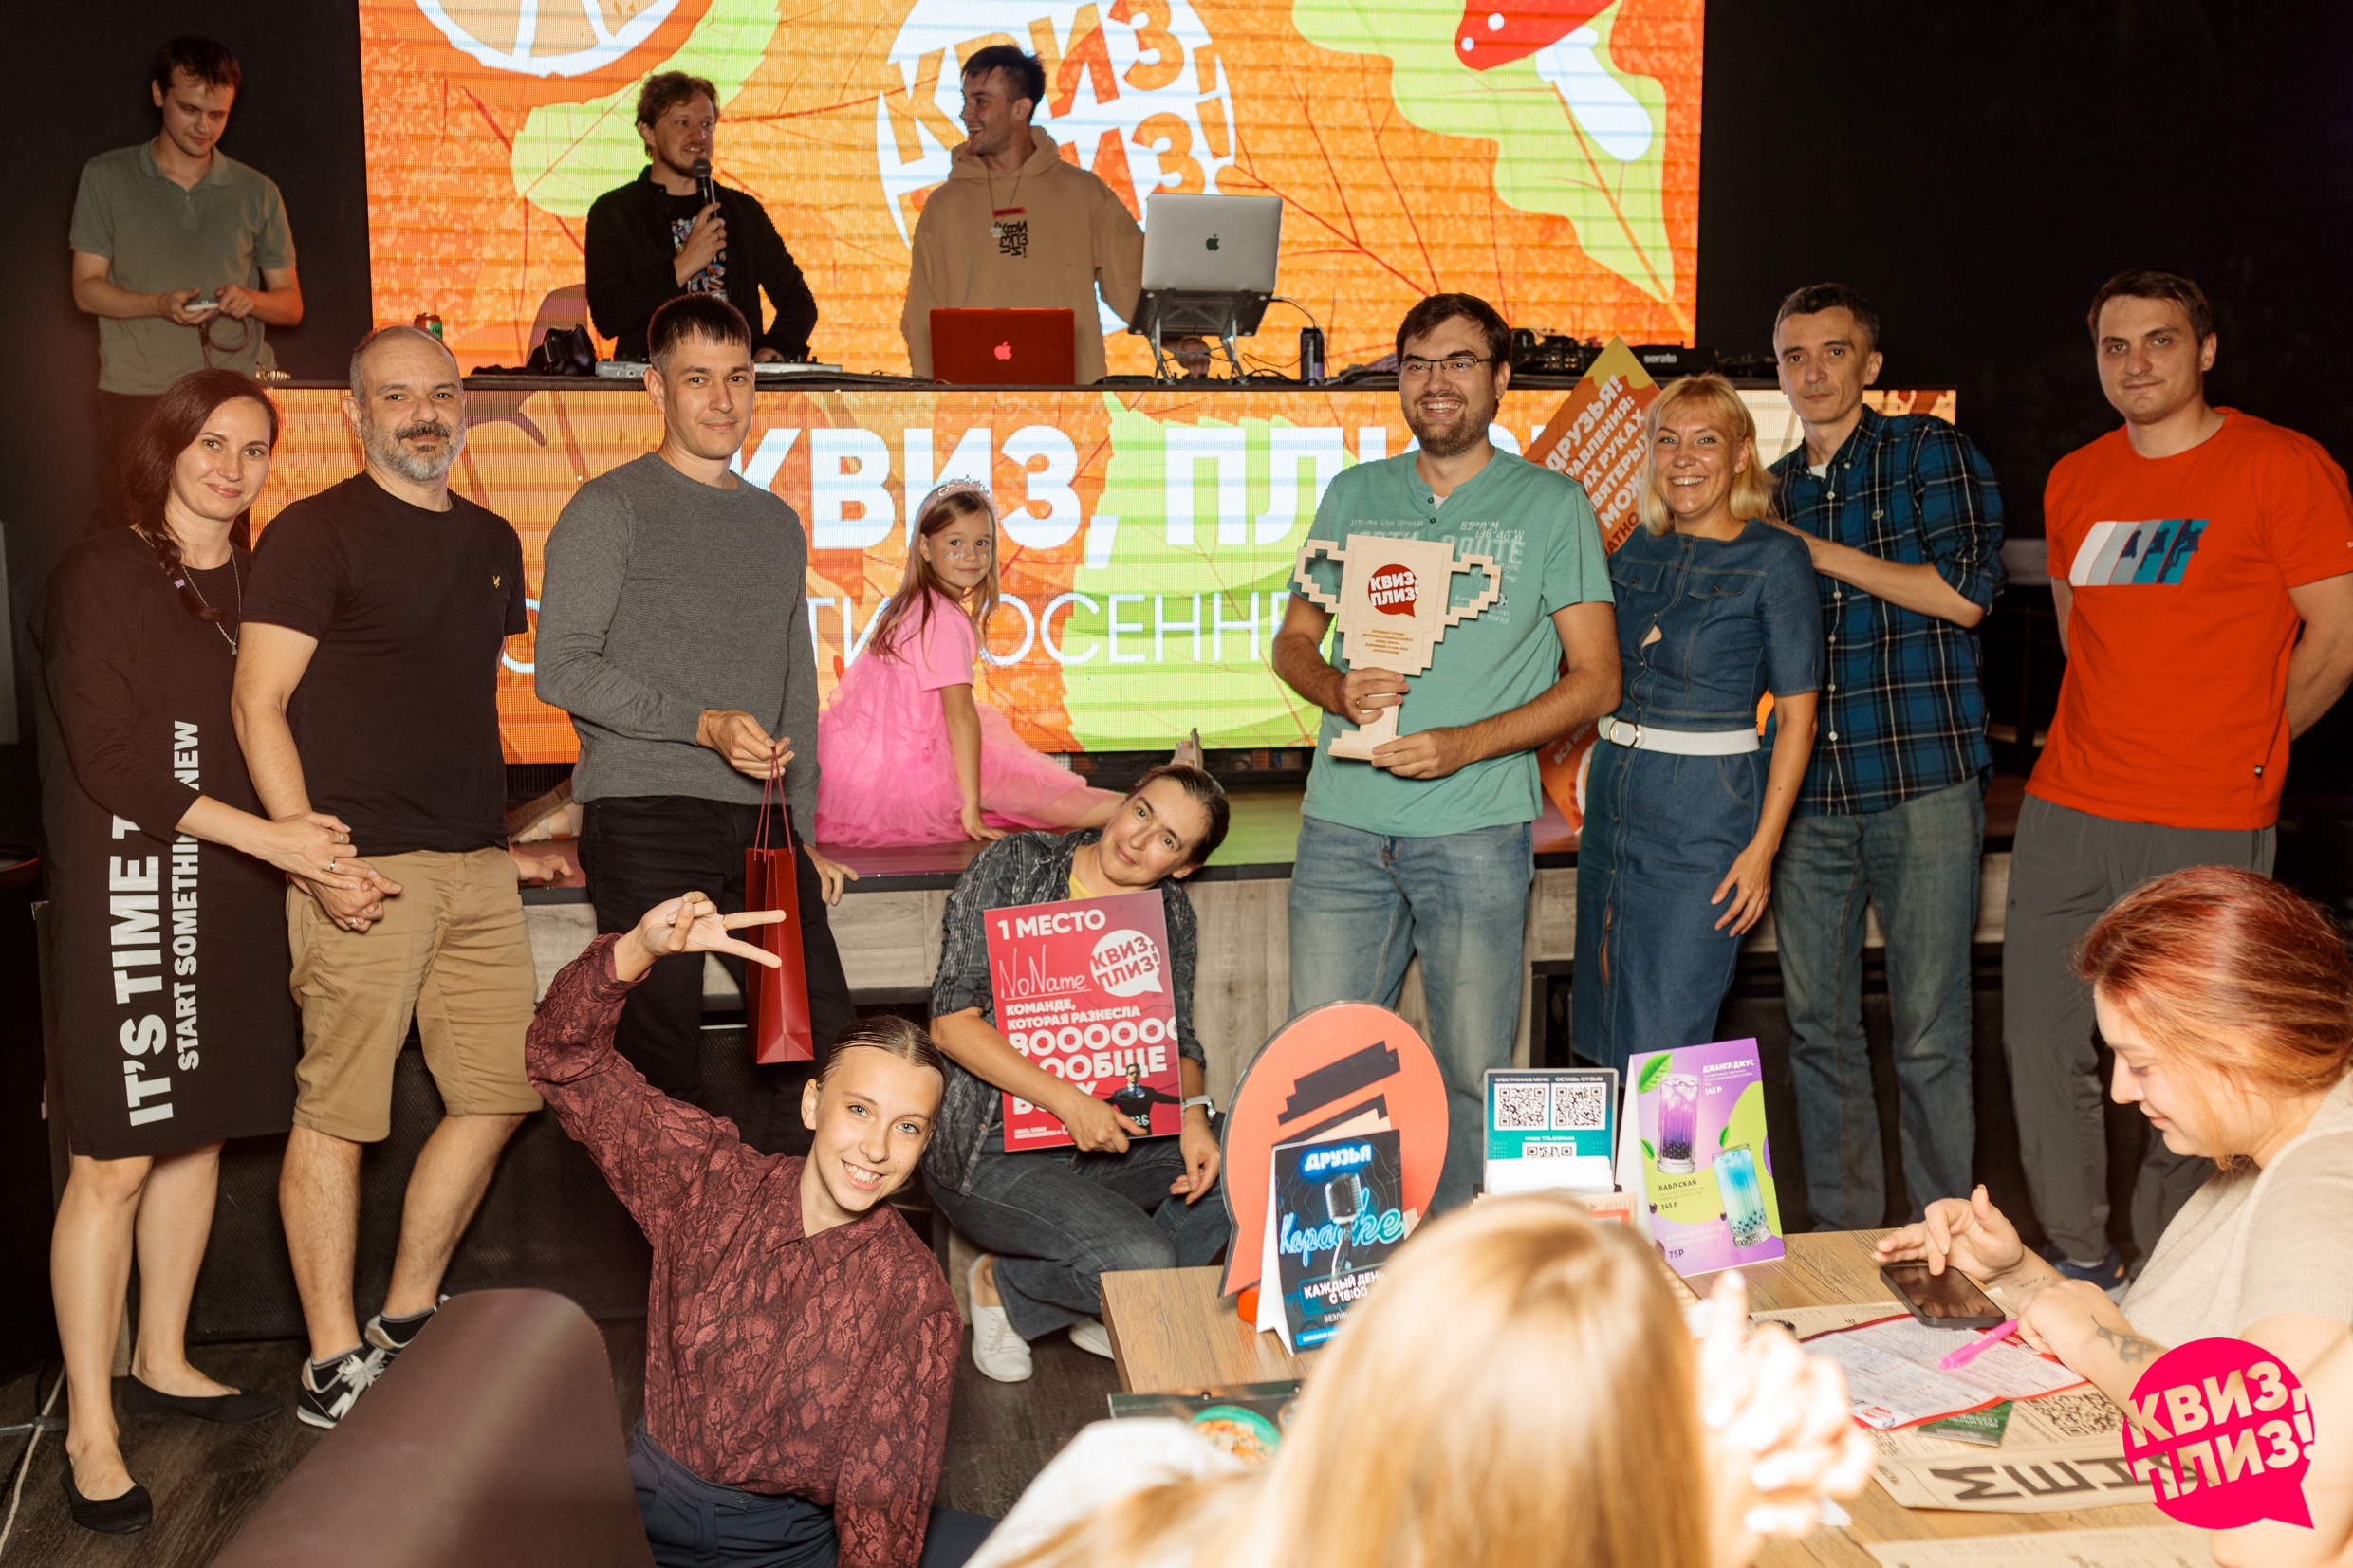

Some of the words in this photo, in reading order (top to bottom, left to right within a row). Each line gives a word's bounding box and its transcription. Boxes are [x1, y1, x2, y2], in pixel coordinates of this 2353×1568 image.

[887, 0, 1218, 164] КИЗ,
[1643, 353, 1677, 364] serato
[1545, 374, 1624, 471] ДРУЗЬЯ!
[1566, 396, 1636, 477] РАВЛЕНИЯ:
[1598, 408, 1646, 469] РУКАХ
[1590, 434, 1649, 512] ВЯТЕРЫ
[1599, 470, 1649, 529] МОЖ
[1605, 512, 1640, 555] АТНО
[1370, 571, 1419, 591] КВИЗ,
[1370, 586, 1419, 606] ПЛИЗ!
[172, 833, 199, 977] SOMETHI
[109, 855, 162, 1004] TIME
[997, 919, 1010, 940] 1
[1015, 909, 1106, 939] МЕСТО
[999, 944, 1088, 999] NoName
[1091, 936, 1157, 971] КВИЗ,
[1096, 951, 1160, 990] ПЛИЗ!
[1005, 998, 1076, 1017] КОМАНДЕ,
[1007, 1012, 1069, 1031] КОТОРАЯ
[1071, 1005, 1141, 1024] РАЗНЕСЛА
[174, 981, 199, 1071] START
[120, 1013, 174, 1127] IT'S
[1039, 1045, 1167, 1081] ООБЩЕ
[1732, 1059, 1755, 1070] ДЖУС
[1304, 1144, 1372, 1171] ДРУЗЬЯ
[1658, 1182, 1678, 1191] БАБЛ
[1678, 1177, 1697, 1189] СКАЙ
[1669, 1248, 1684, 1260] 75Р
[1304, 1274, 1356, 1299] КАЖДЫЙ
[1339, 1286, 1367, 1302] 18:00
